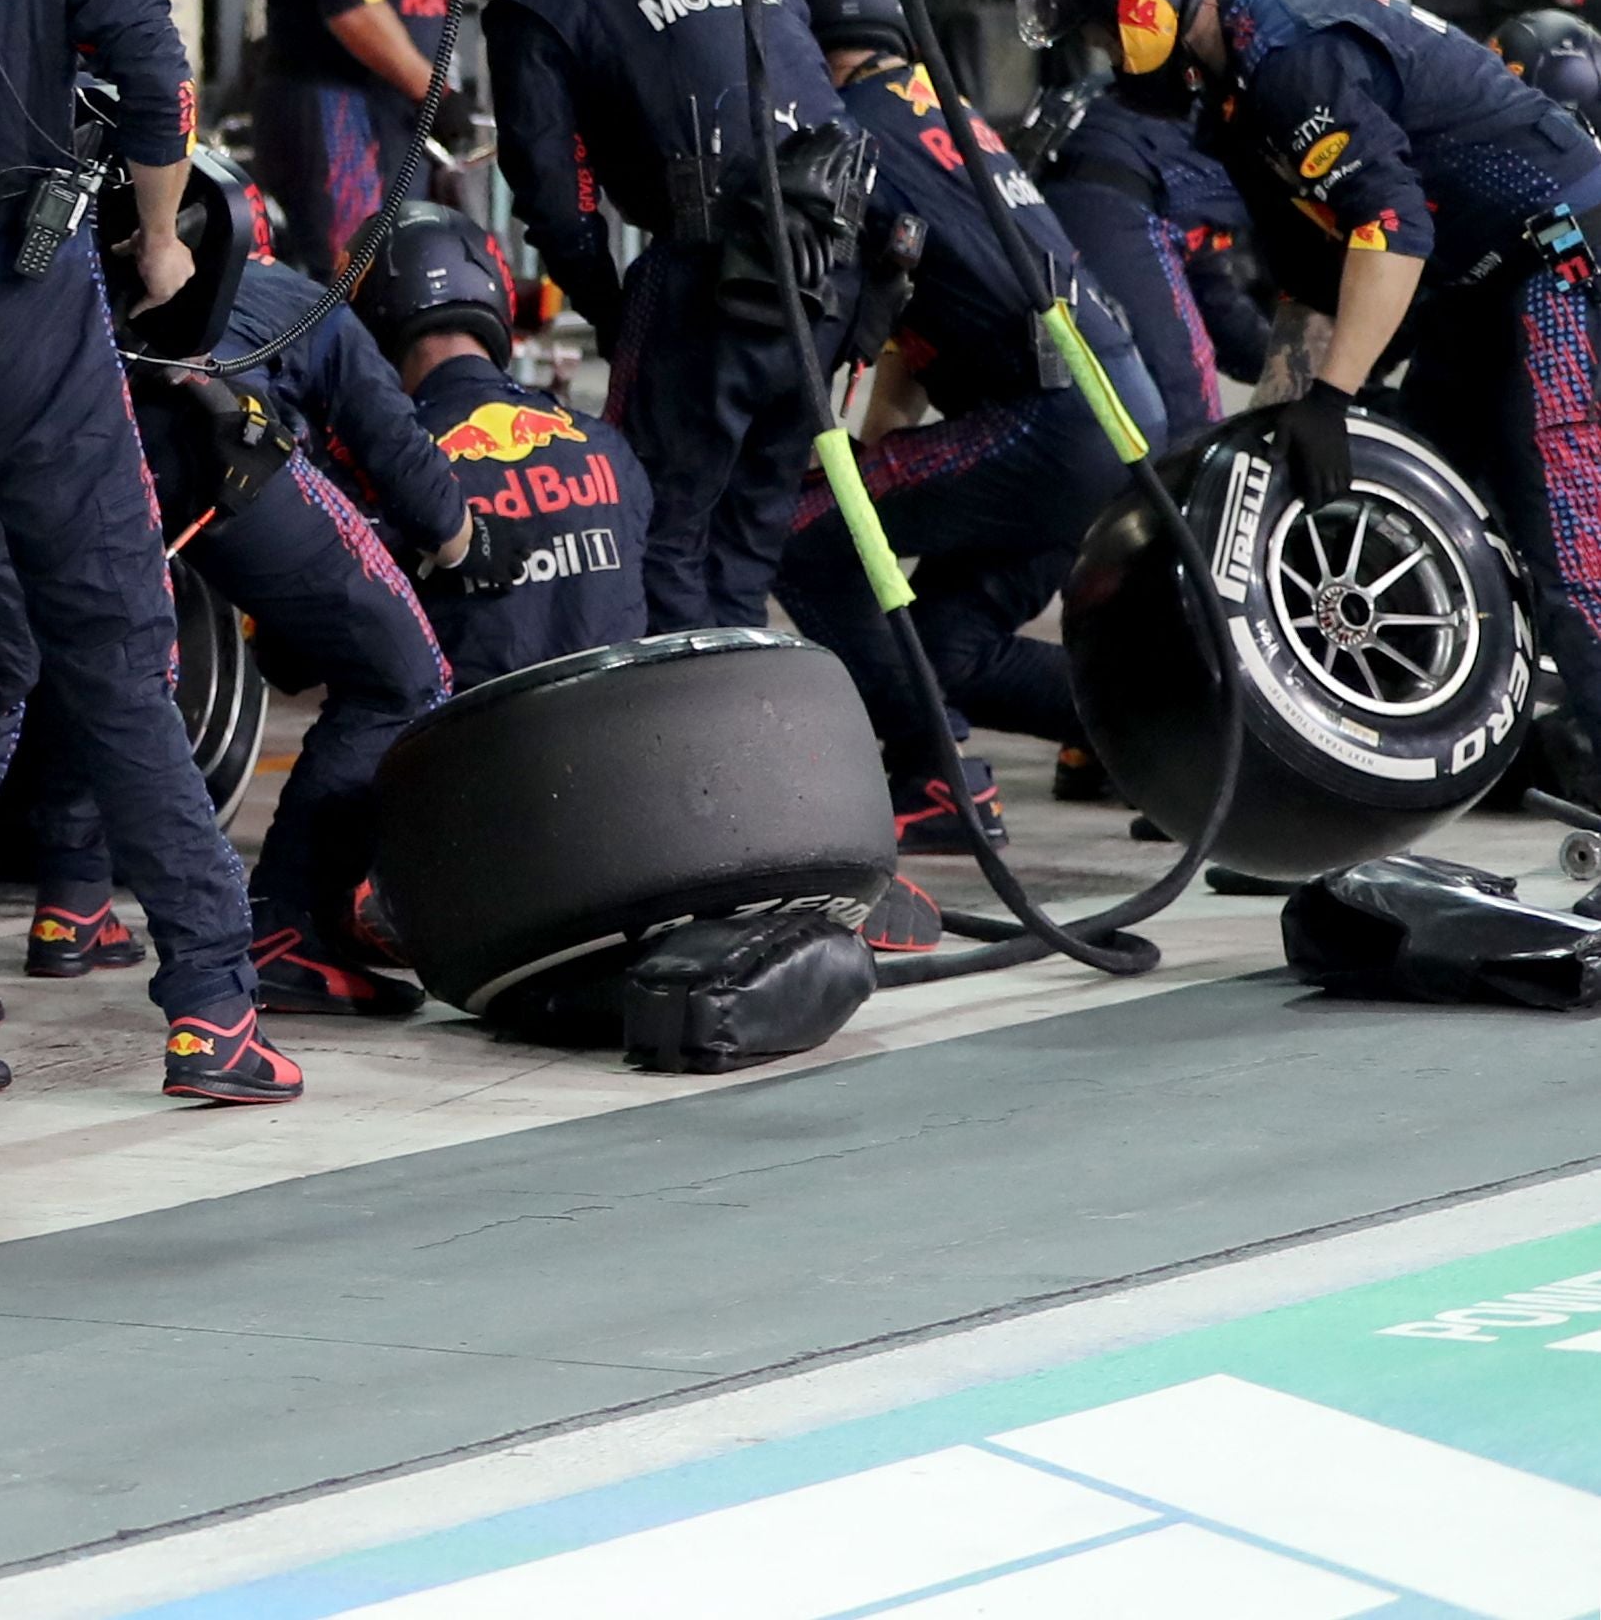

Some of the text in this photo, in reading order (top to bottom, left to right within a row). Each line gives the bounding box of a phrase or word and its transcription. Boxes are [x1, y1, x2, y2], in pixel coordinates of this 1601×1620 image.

[525, 453, 621, 514] Bull
[1211, 451, 1273, 604] PIRELLI
[1451, 600, 1534, 776] ZERO
